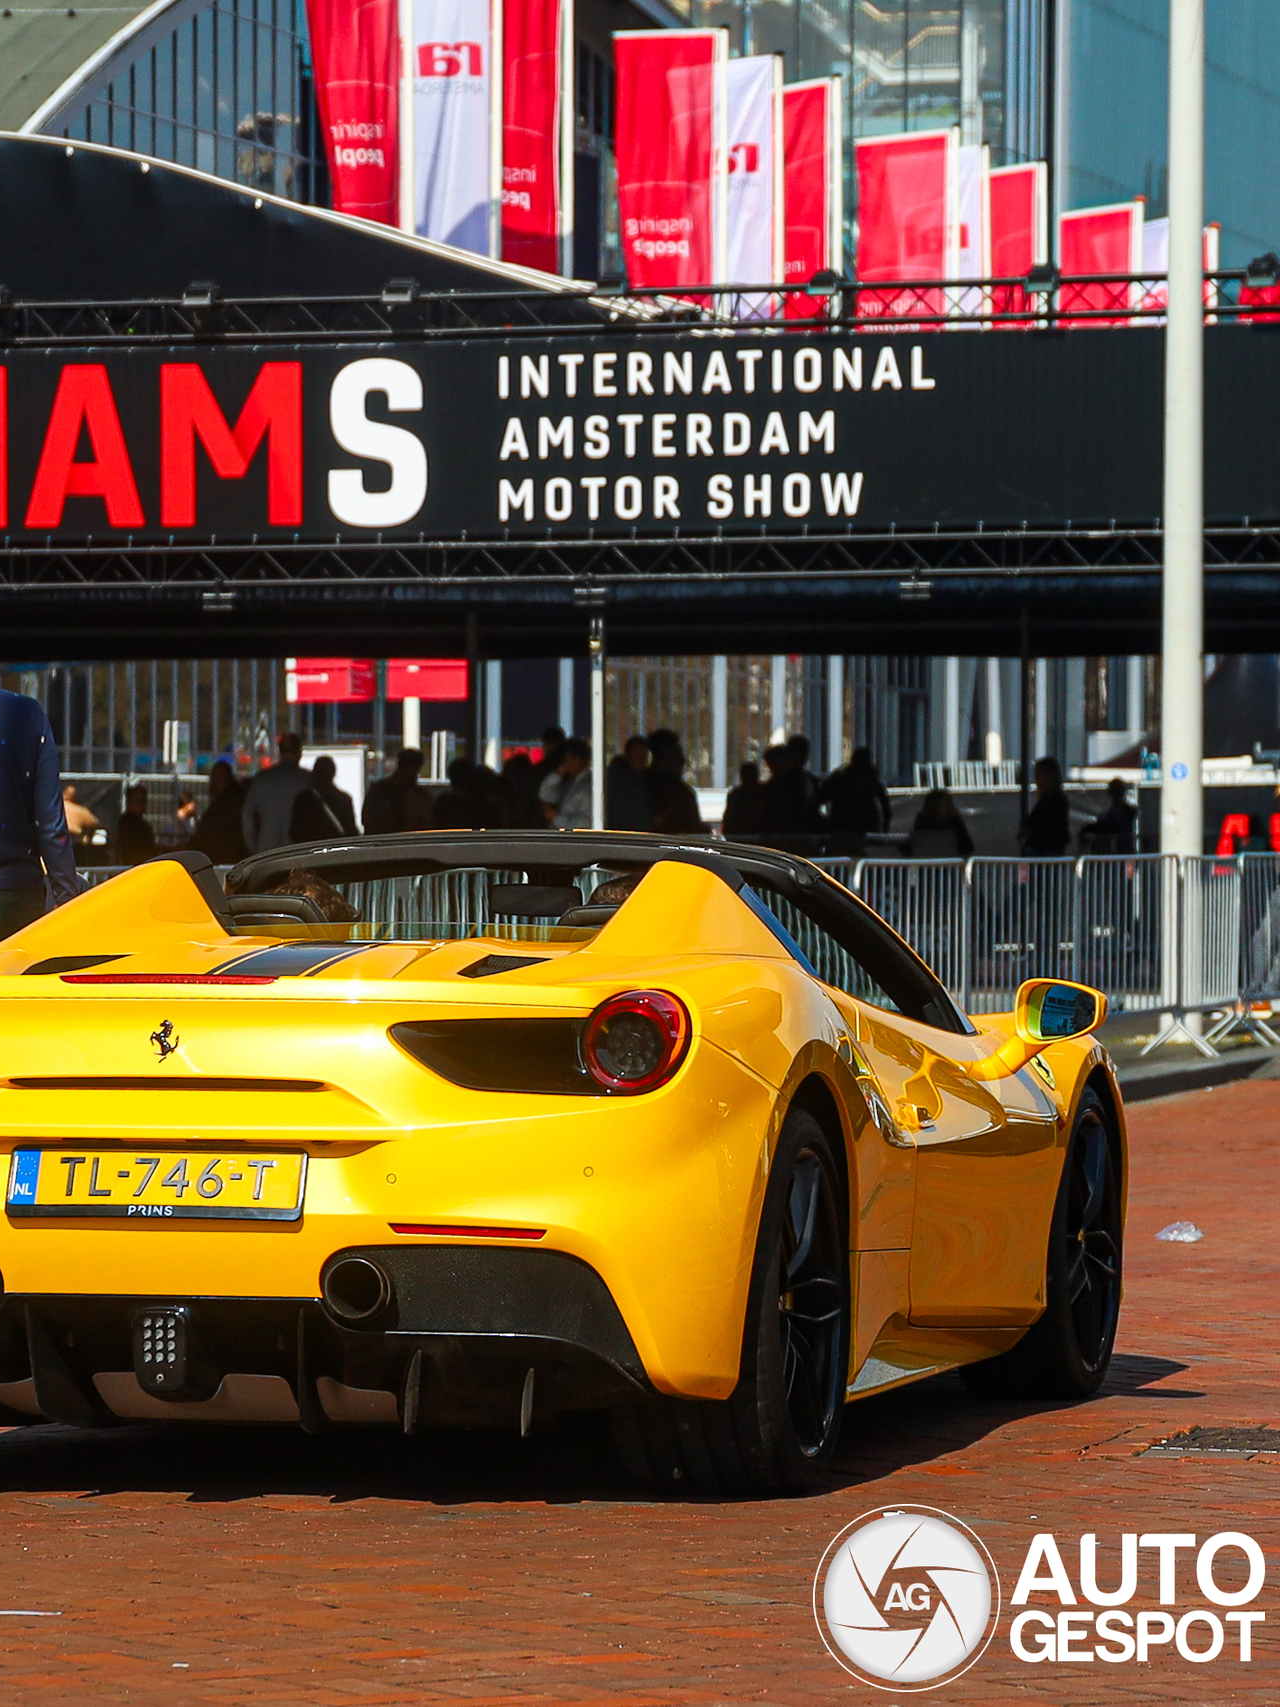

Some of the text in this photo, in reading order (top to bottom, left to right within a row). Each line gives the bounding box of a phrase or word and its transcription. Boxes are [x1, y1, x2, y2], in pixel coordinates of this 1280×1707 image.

[498, 346, 936, 399] INTERNATIONAL
[499, 410, 836, 461] AMSTERDAM
[498, 472, 864, 522] MOTOR SHOW
[14, 1182, 33, 1196] NL
[61, 1157, 277, 1200] TL-746-T
[127, 1204, 174, 1217] PRINS
